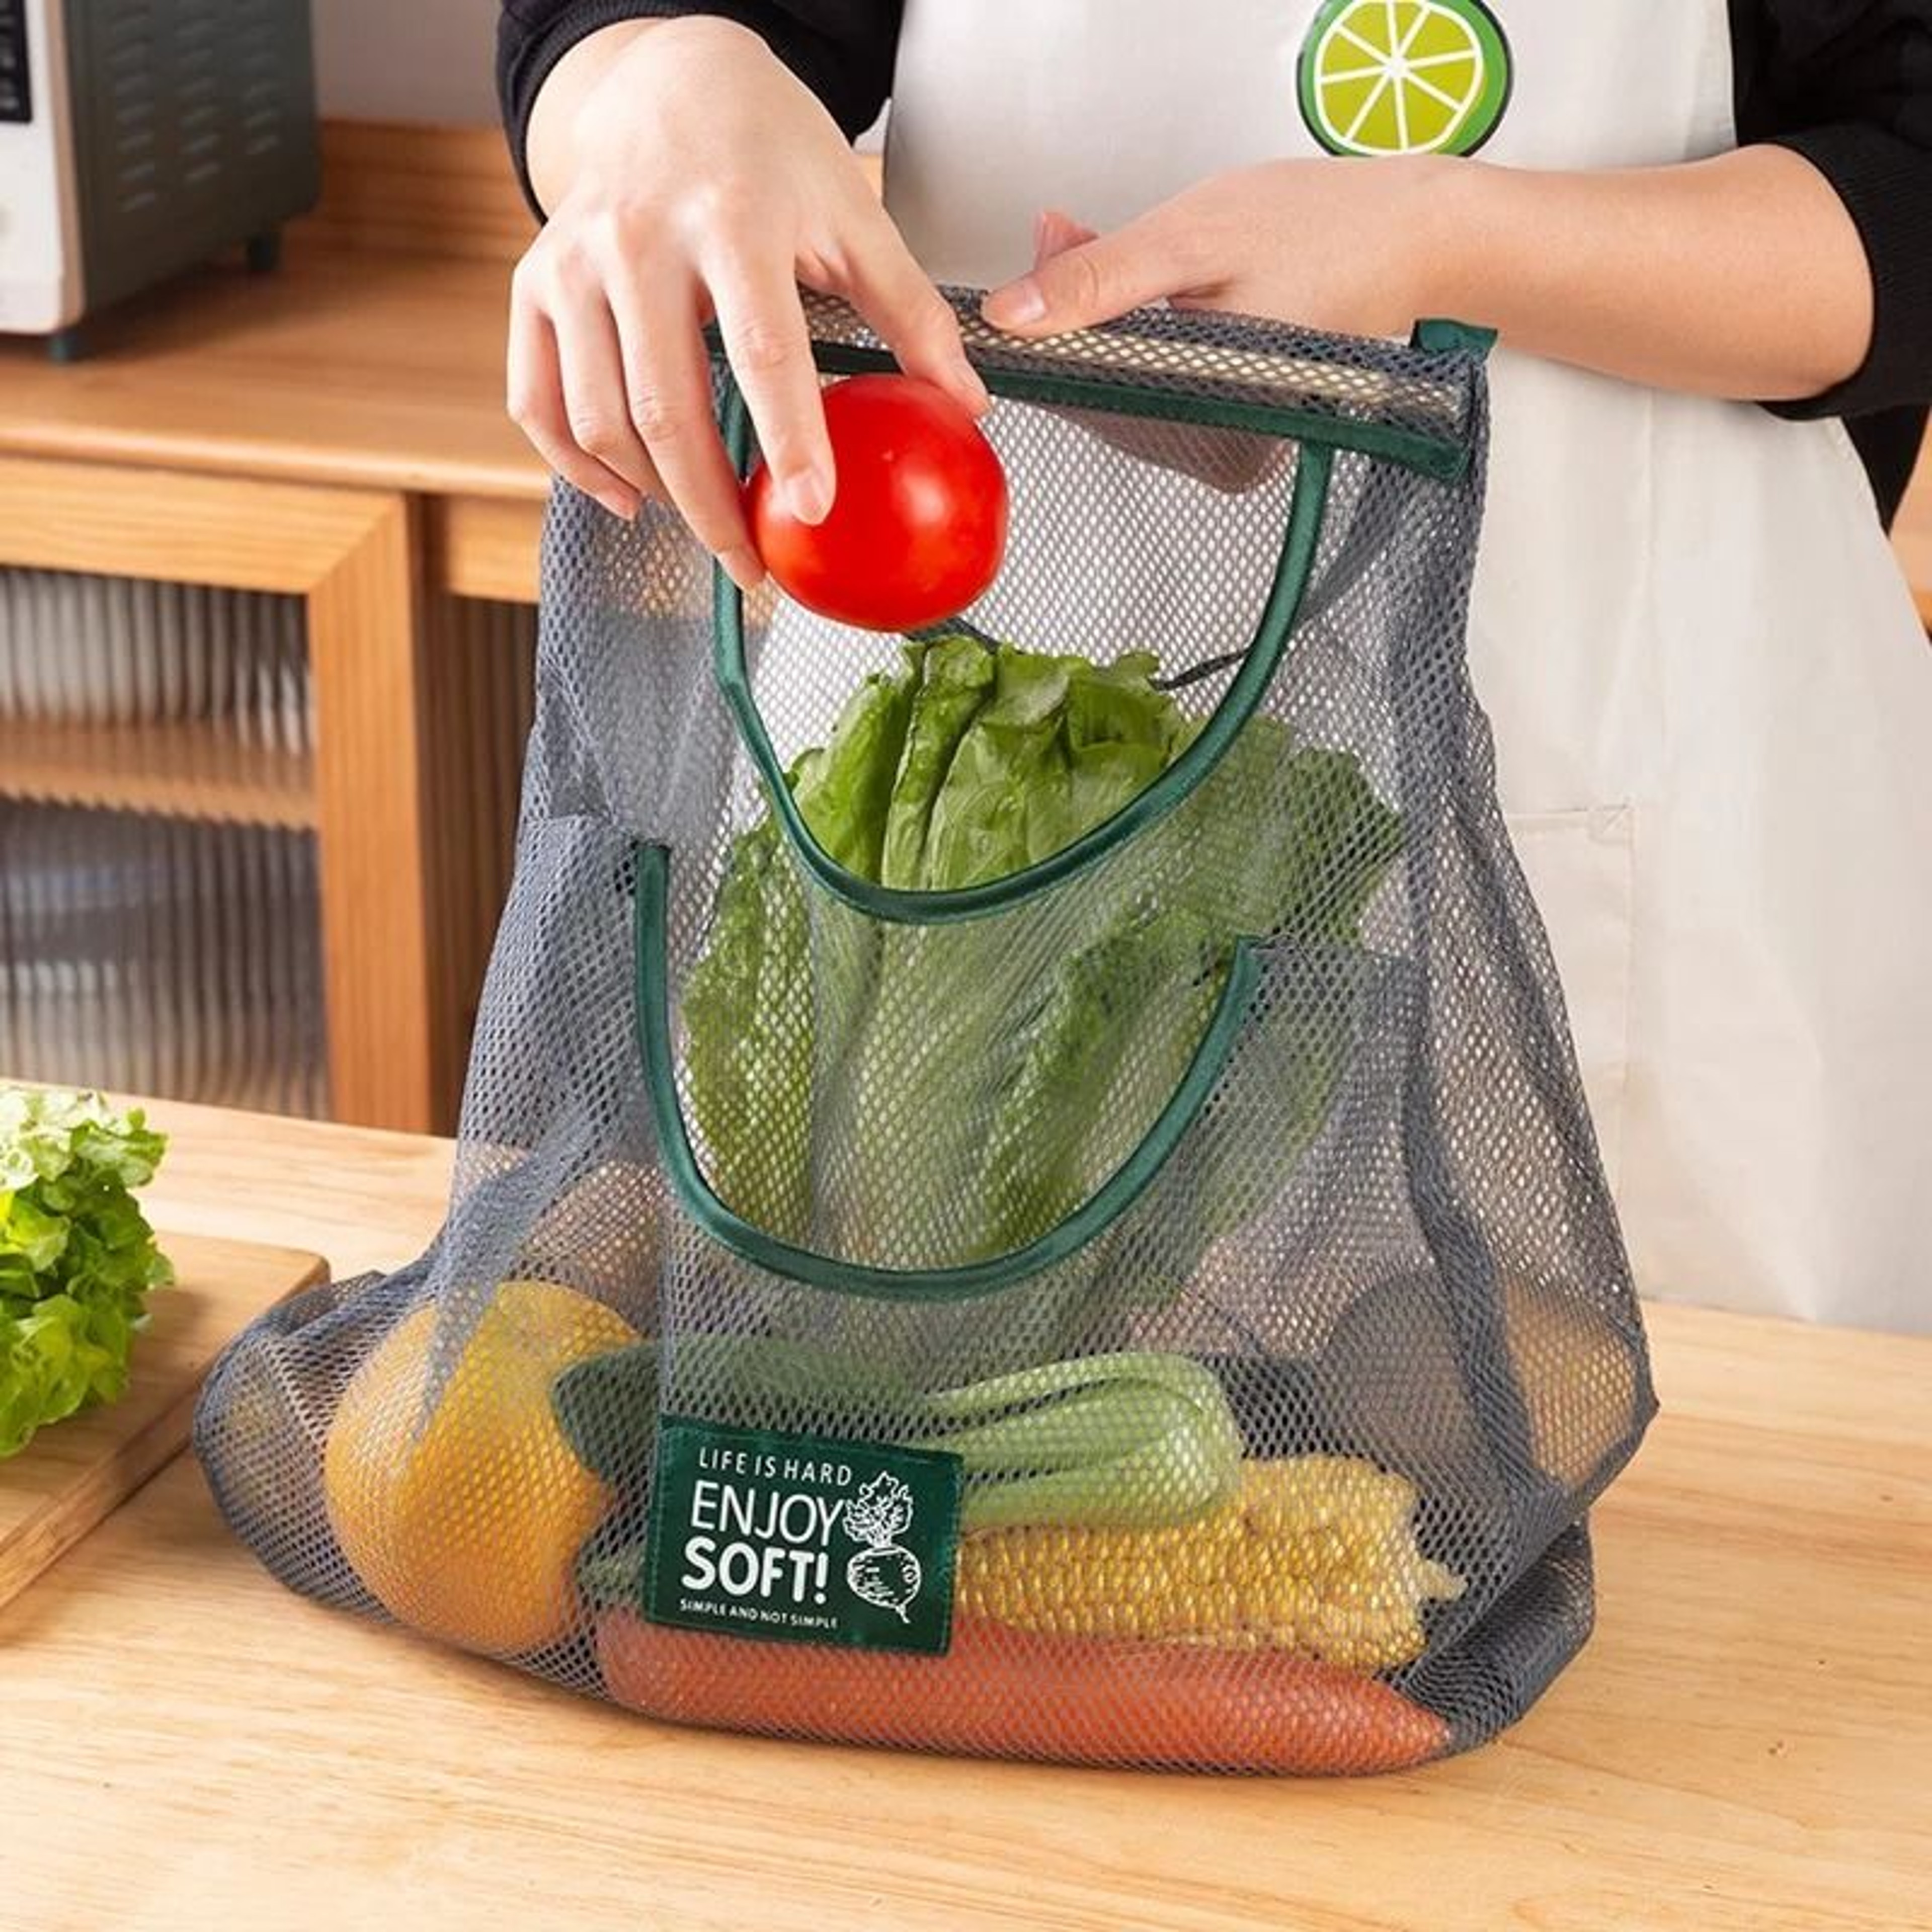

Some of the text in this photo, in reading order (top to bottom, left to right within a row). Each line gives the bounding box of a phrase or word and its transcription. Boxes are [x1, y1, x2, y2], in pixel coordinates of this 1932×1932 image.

[699, 1446, 852, 1486] LIFE IS HARD
[691, 1479, 844, 1546] ENJOY
[681, 1536, 829, 1605] SOFT!
[680, 1598, 838, 1629] SIMPLE AND NOT SIMPLE
